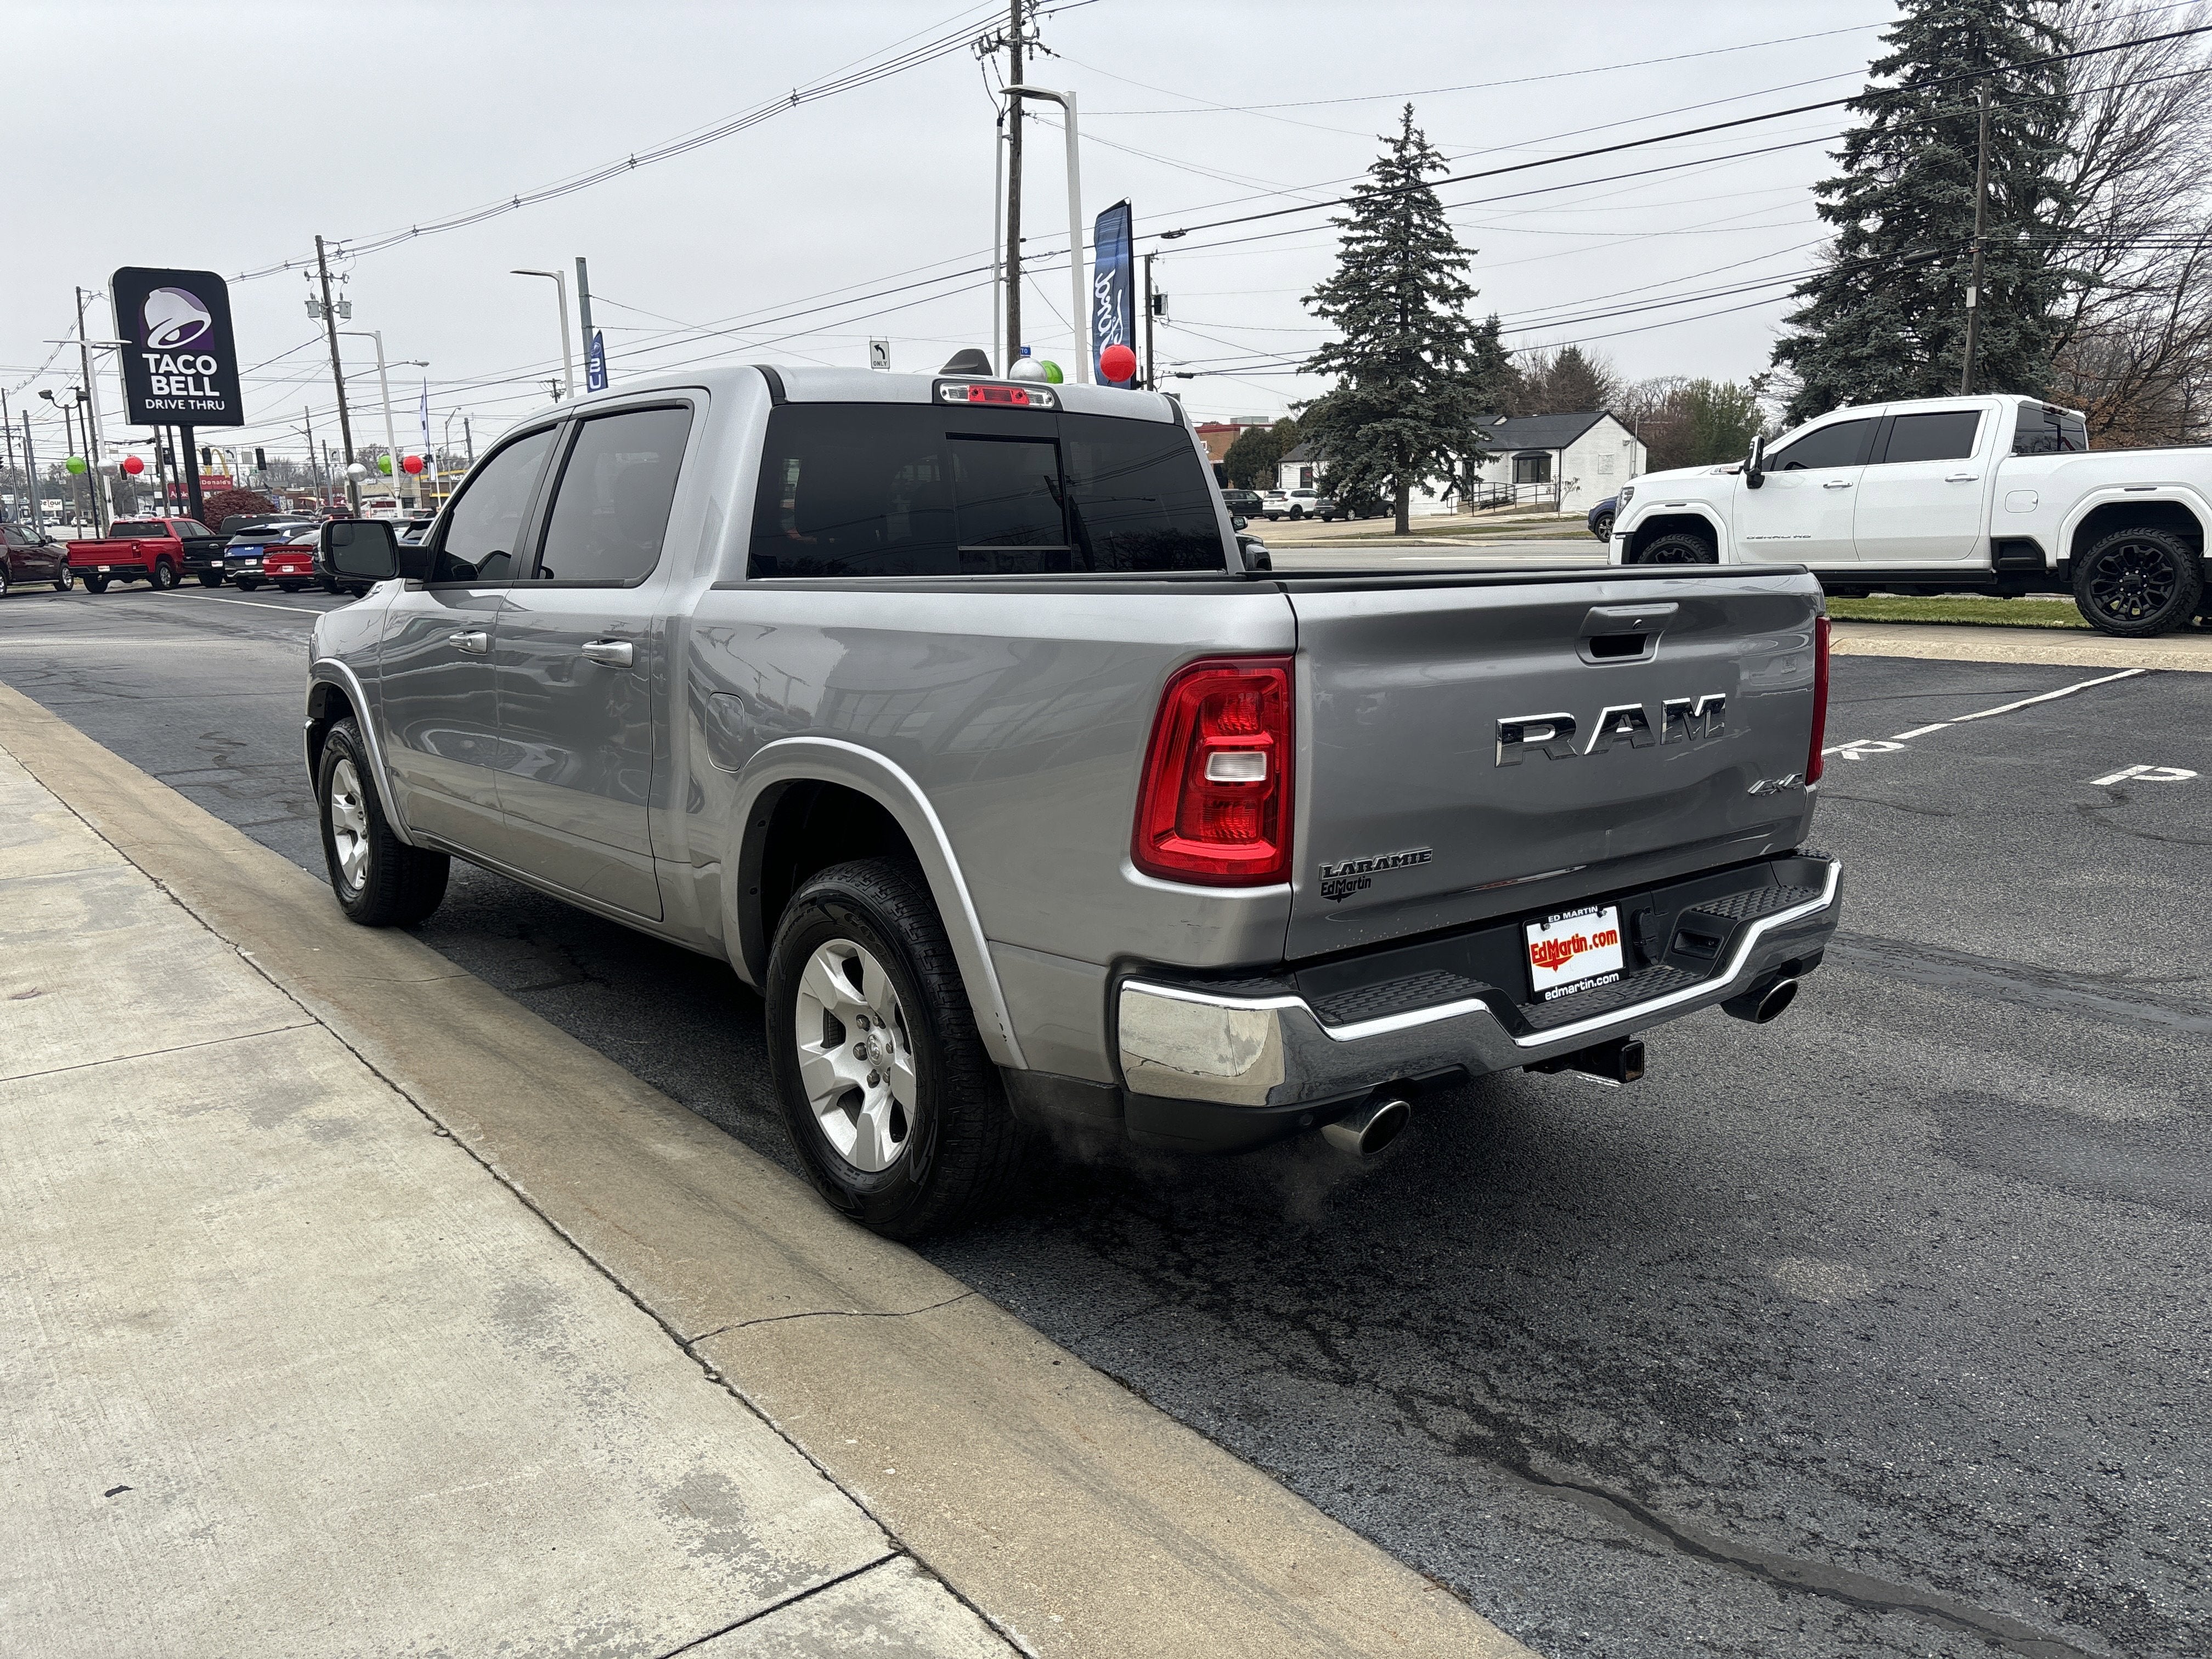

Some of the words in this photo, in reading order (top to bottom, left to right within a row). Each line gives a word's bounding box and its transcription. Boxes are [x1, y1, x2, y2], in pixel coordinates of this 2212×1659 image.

[142, 353, 217, 375] TACO
[151, 375, 220, 397] BELL
[145, 399, 186, 410] DRIVE
[188, 399, 225, 410] THRU
[1494, 693, 1726, 768] RAM
[2089, 765, 2198, 786] P
[1319, 848, 1434, 880] LARAMIE
[1321, 876, 1372, 896] EdMartin
[1548, 915, 1561, 923] ED
[1562, 906, 1599, 919] MARTIN
[1530, 929, 1618, 964] EdMartin.com
[1544, 973, 1620, 1001] edmartin.com
